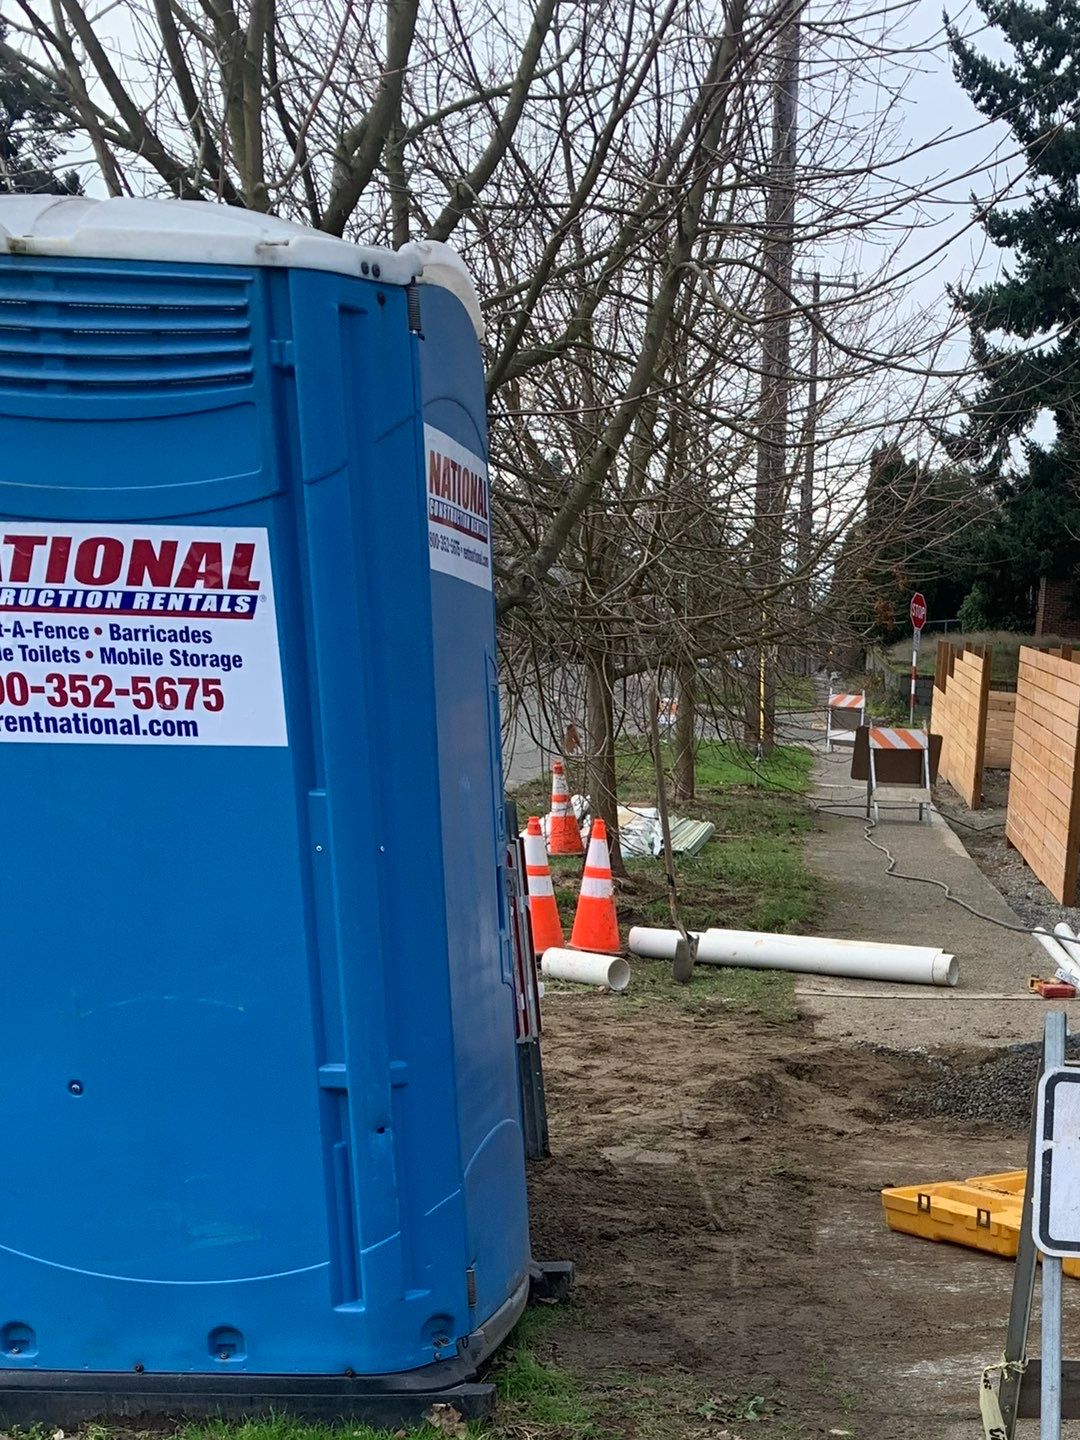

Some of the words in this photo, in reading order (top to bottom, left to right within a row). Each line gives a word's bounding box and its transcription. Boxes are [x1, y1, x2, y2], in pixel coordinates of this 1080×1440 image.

[429, 449, 488, 520] NATIONAL
[0, 534, 261, 591] TIONAL
[132, 592, 252, 614] RENTALS
[912, 603, 926, 619] STOP
[108, 623, 213, 645] Barricades
[18, 644, 81, 664] Toilets
[100, 646, 164, 667] Mobile
[170, 649, 243, 672] Storage
[0, 671, 225, 712] 0-352-5675
